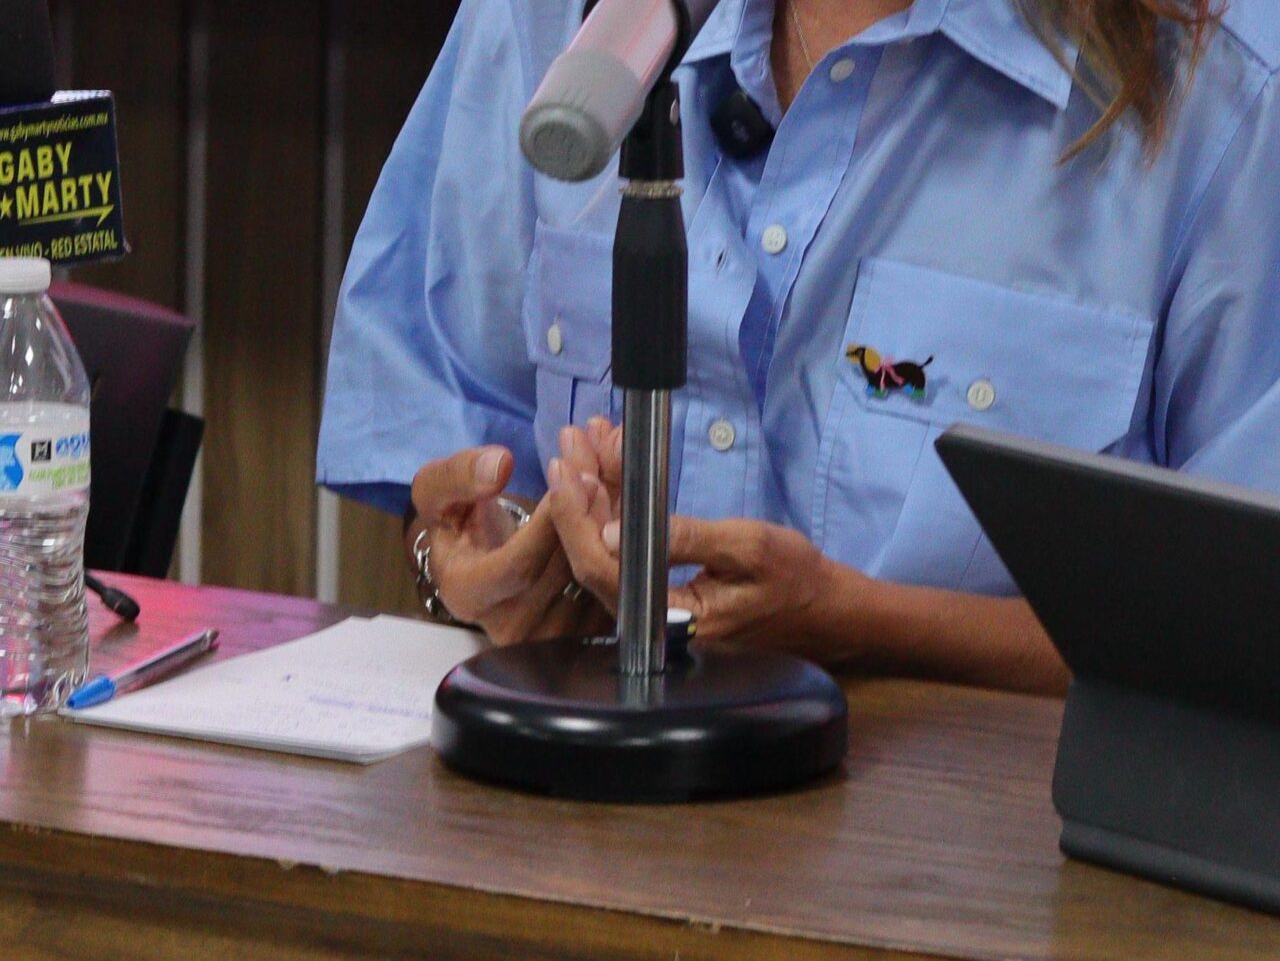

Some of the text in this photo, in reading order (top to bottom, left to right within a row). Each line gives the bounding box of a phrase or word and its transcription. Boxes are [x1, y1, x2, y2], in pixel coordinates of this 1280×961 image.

[0, 141, 73, 186] GABY
[15, 170, 113, 220] MARTY
[51, 235, 73, 259] RED
[74, 228, 118, 255] ESTATAL
